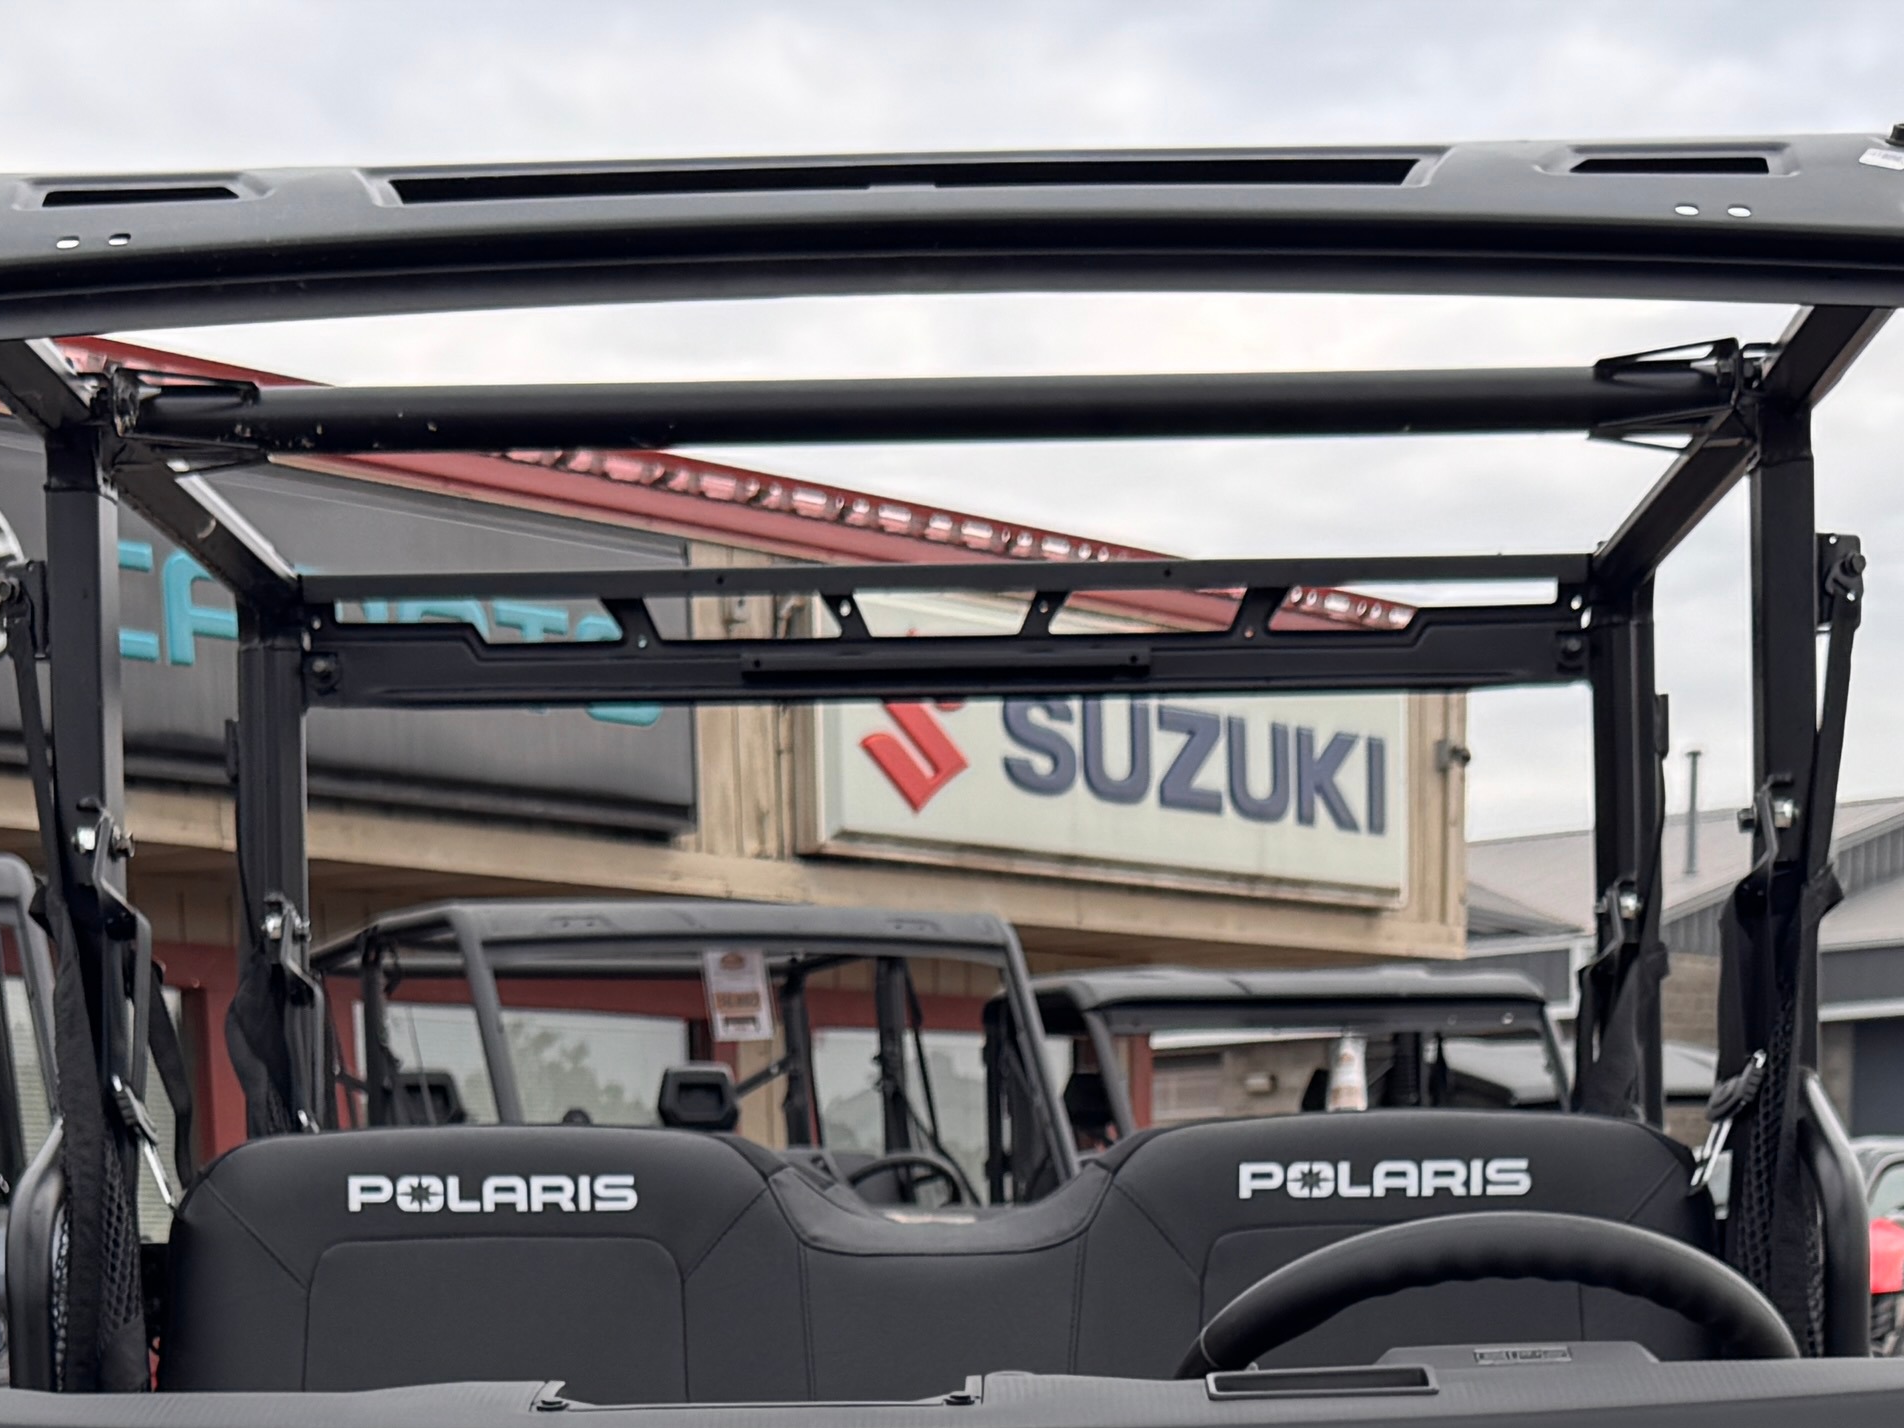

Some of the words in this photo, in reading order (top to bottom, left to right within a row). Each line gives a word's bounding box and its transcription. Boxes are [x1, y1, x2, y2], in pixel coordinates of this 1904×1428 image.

[1001, 695, 1386, 837] SUZUKI
[346, 1173, 639, 1214] POLARIS
[1237, 1156, 1533, 1200] POLARIS
